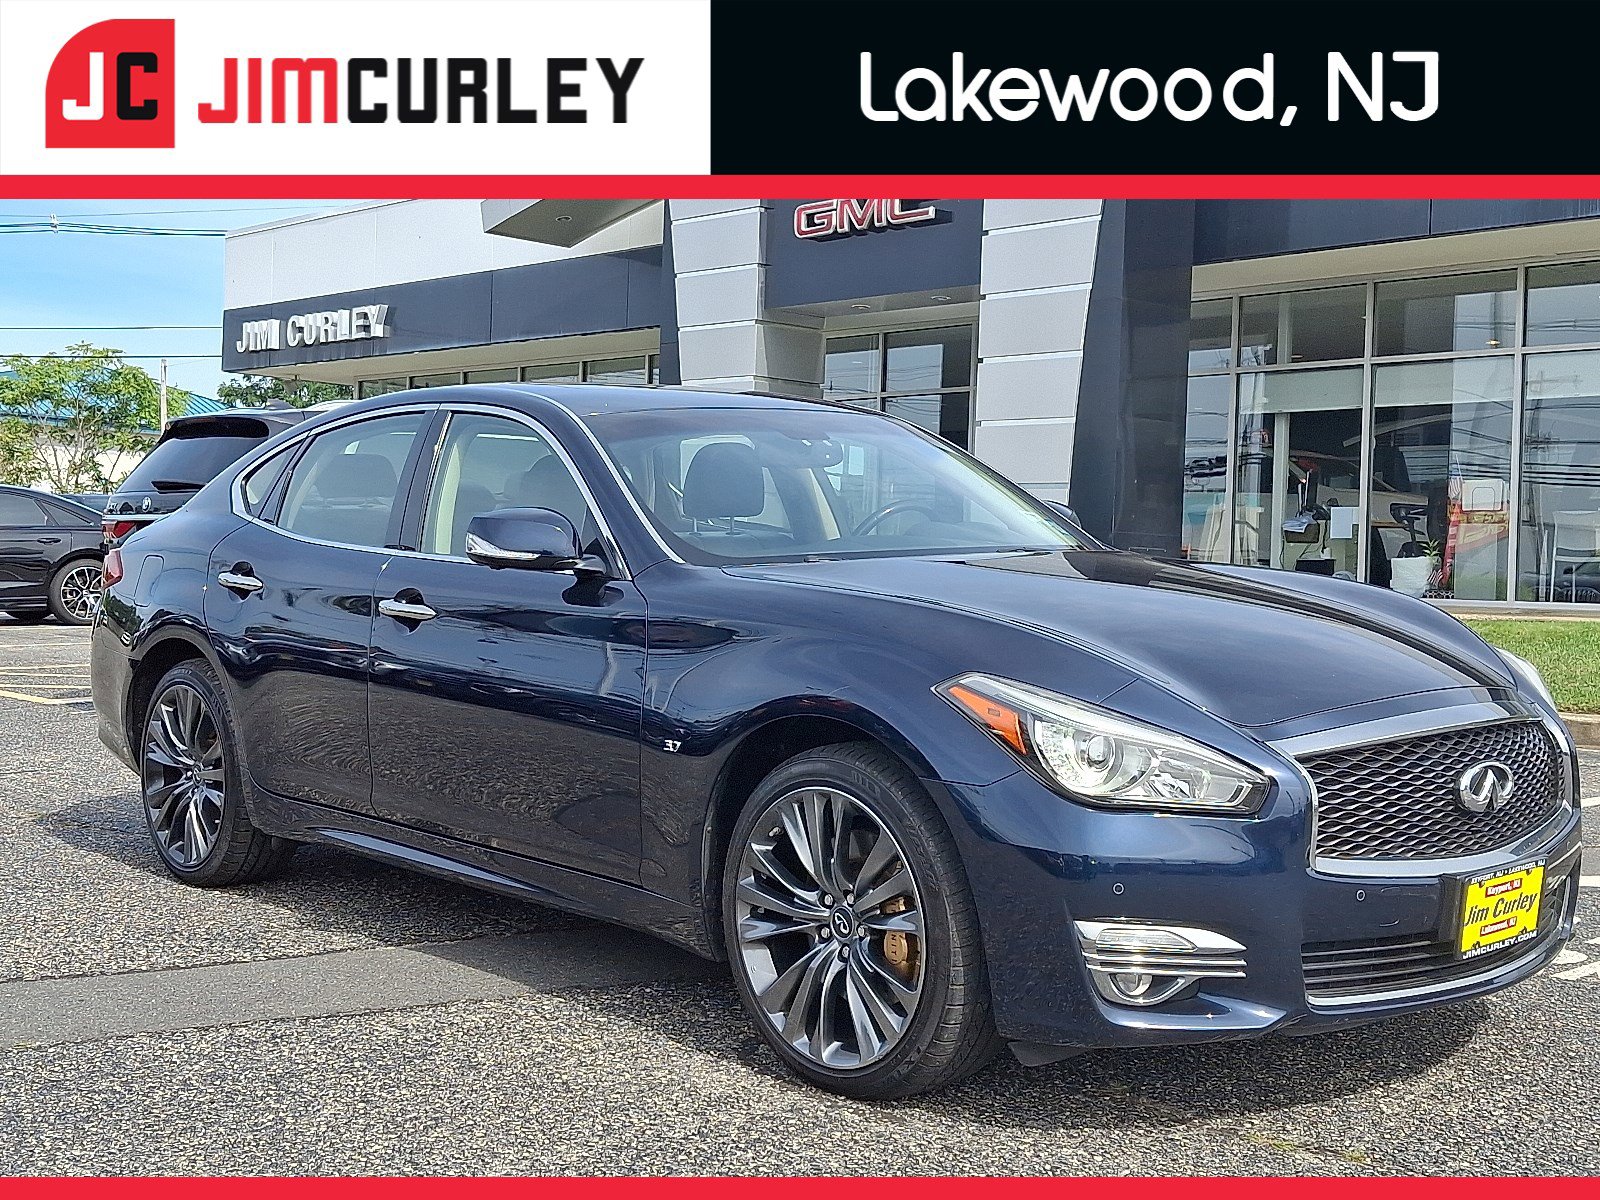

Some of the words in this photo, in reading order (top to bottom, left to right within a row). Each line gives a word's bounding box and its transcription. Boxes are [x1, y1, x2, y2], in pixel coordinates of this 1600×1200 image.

[794, 199, 935, 238] GMC
[236, 319, 284, 353] JIM
[286, 304, 390, 348] CURLEY
[1464, 904, 1489, 926] Jim
[1493, 892, 1538, 919] Curley
[1463, 930, 1538, 959] JIMCURLEY.COM
